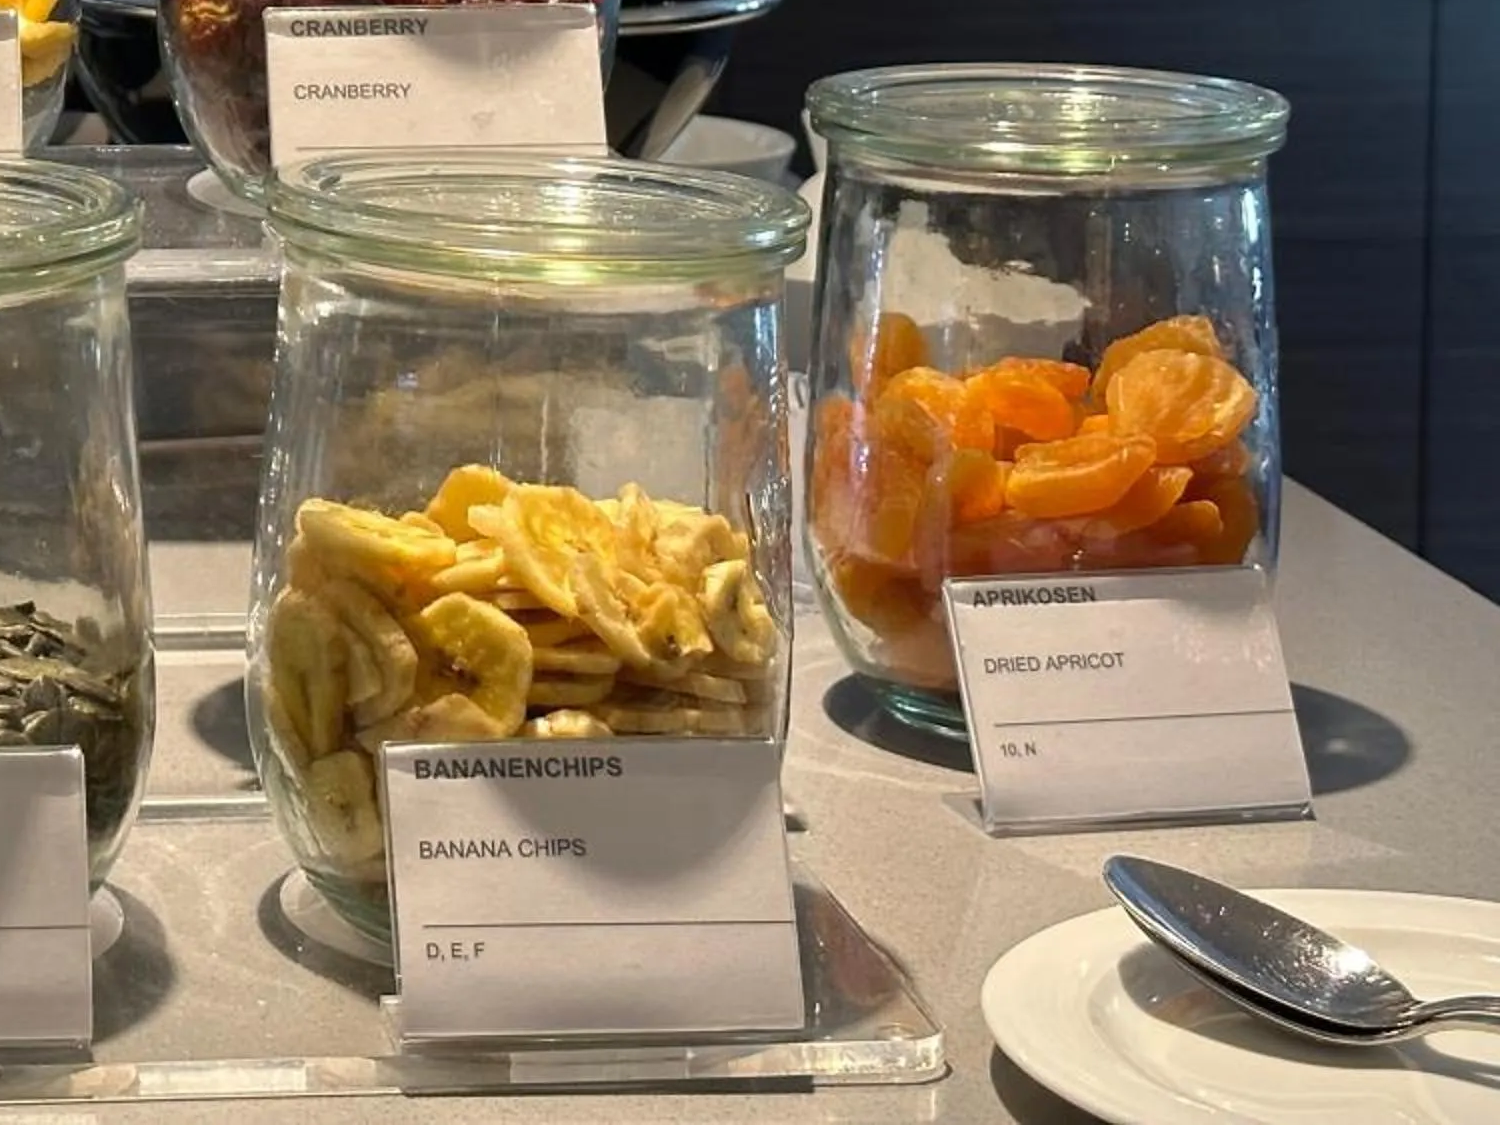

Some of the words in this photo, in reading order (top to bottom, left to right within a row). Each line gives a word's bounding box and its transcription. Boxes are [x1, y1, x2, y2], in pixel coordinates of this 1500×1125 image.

[290, 18, 429, 37] CRANBERRY
[293, 82, 412, 101] CRANBERRY
[972, 585, 1099, 609] APRIKOSEN
[983, 655, 1042, 675] DRIED
[1045, 652, 1126, 672] APRICOT
[1024, 741, 1037, 757] N
[414, 756, 623, 780] BANANENCHIPS
[418, 839, 512, 860] BANANA
[517, 838, 588, 858] CHIPS
[474, 941, 486, 959] F
